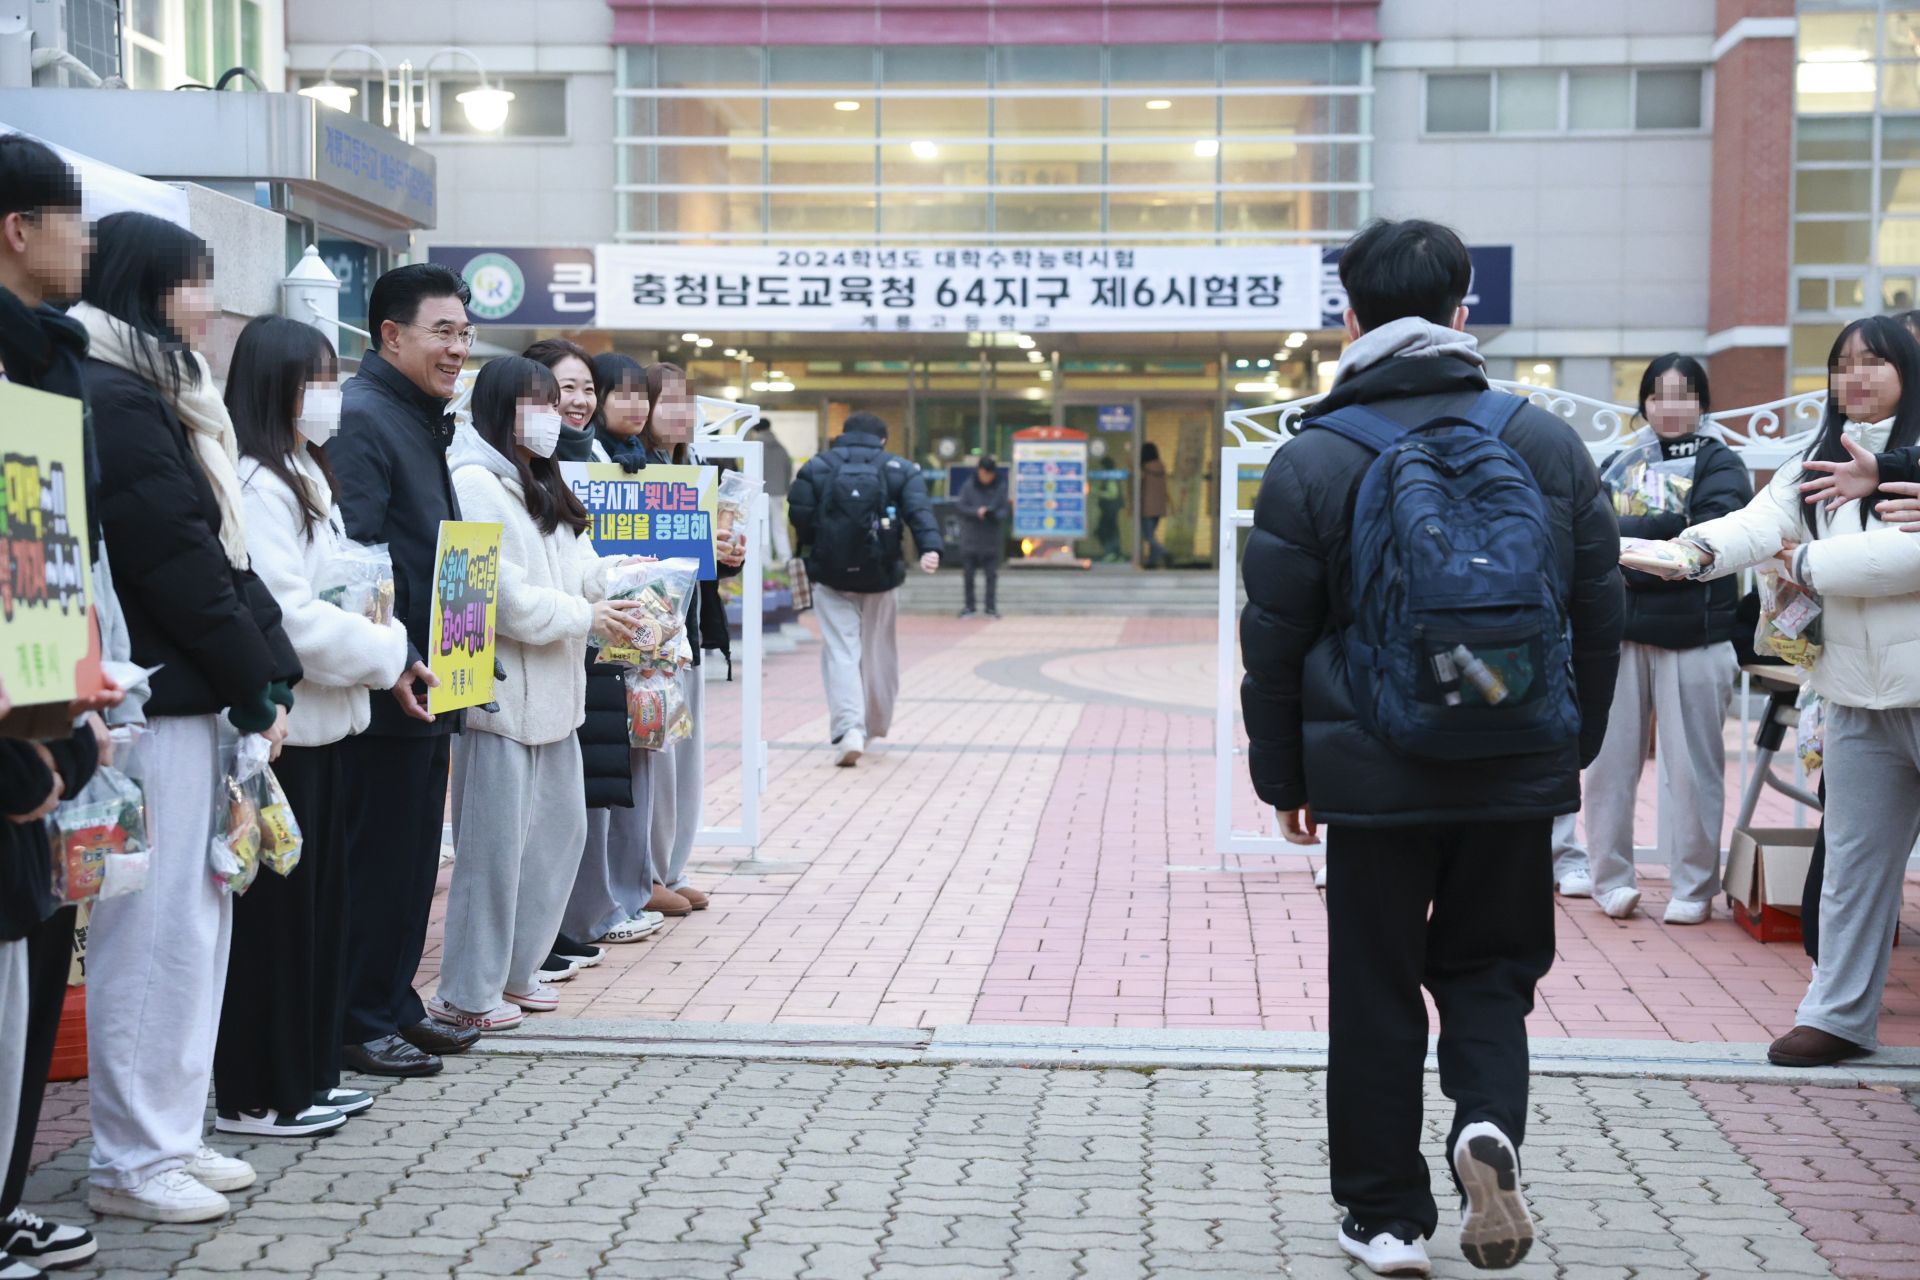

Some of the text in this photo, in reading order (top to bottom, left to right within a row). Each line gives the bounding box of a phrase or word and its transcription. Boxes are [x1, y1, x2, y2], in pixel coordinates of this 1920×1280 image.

[777, 250, 1135, 269] 2024학년도 대학수학능력시험
[633, 274, 915, 308] 충청남도교육청
[935, 276, 1070, 308] 64지구
[1090, 275, 1283, 308] 제6시험장
[644, 482, 699, 511] 빛나는
[600, 512, 650, 541] 내일을
[655, 512, 708, 541] 응원해
[439, 548, 497, 601] 수험생 여러분
[600, 930, 633, 940] rocs
[456, 1014, 491, 1028] crocs
